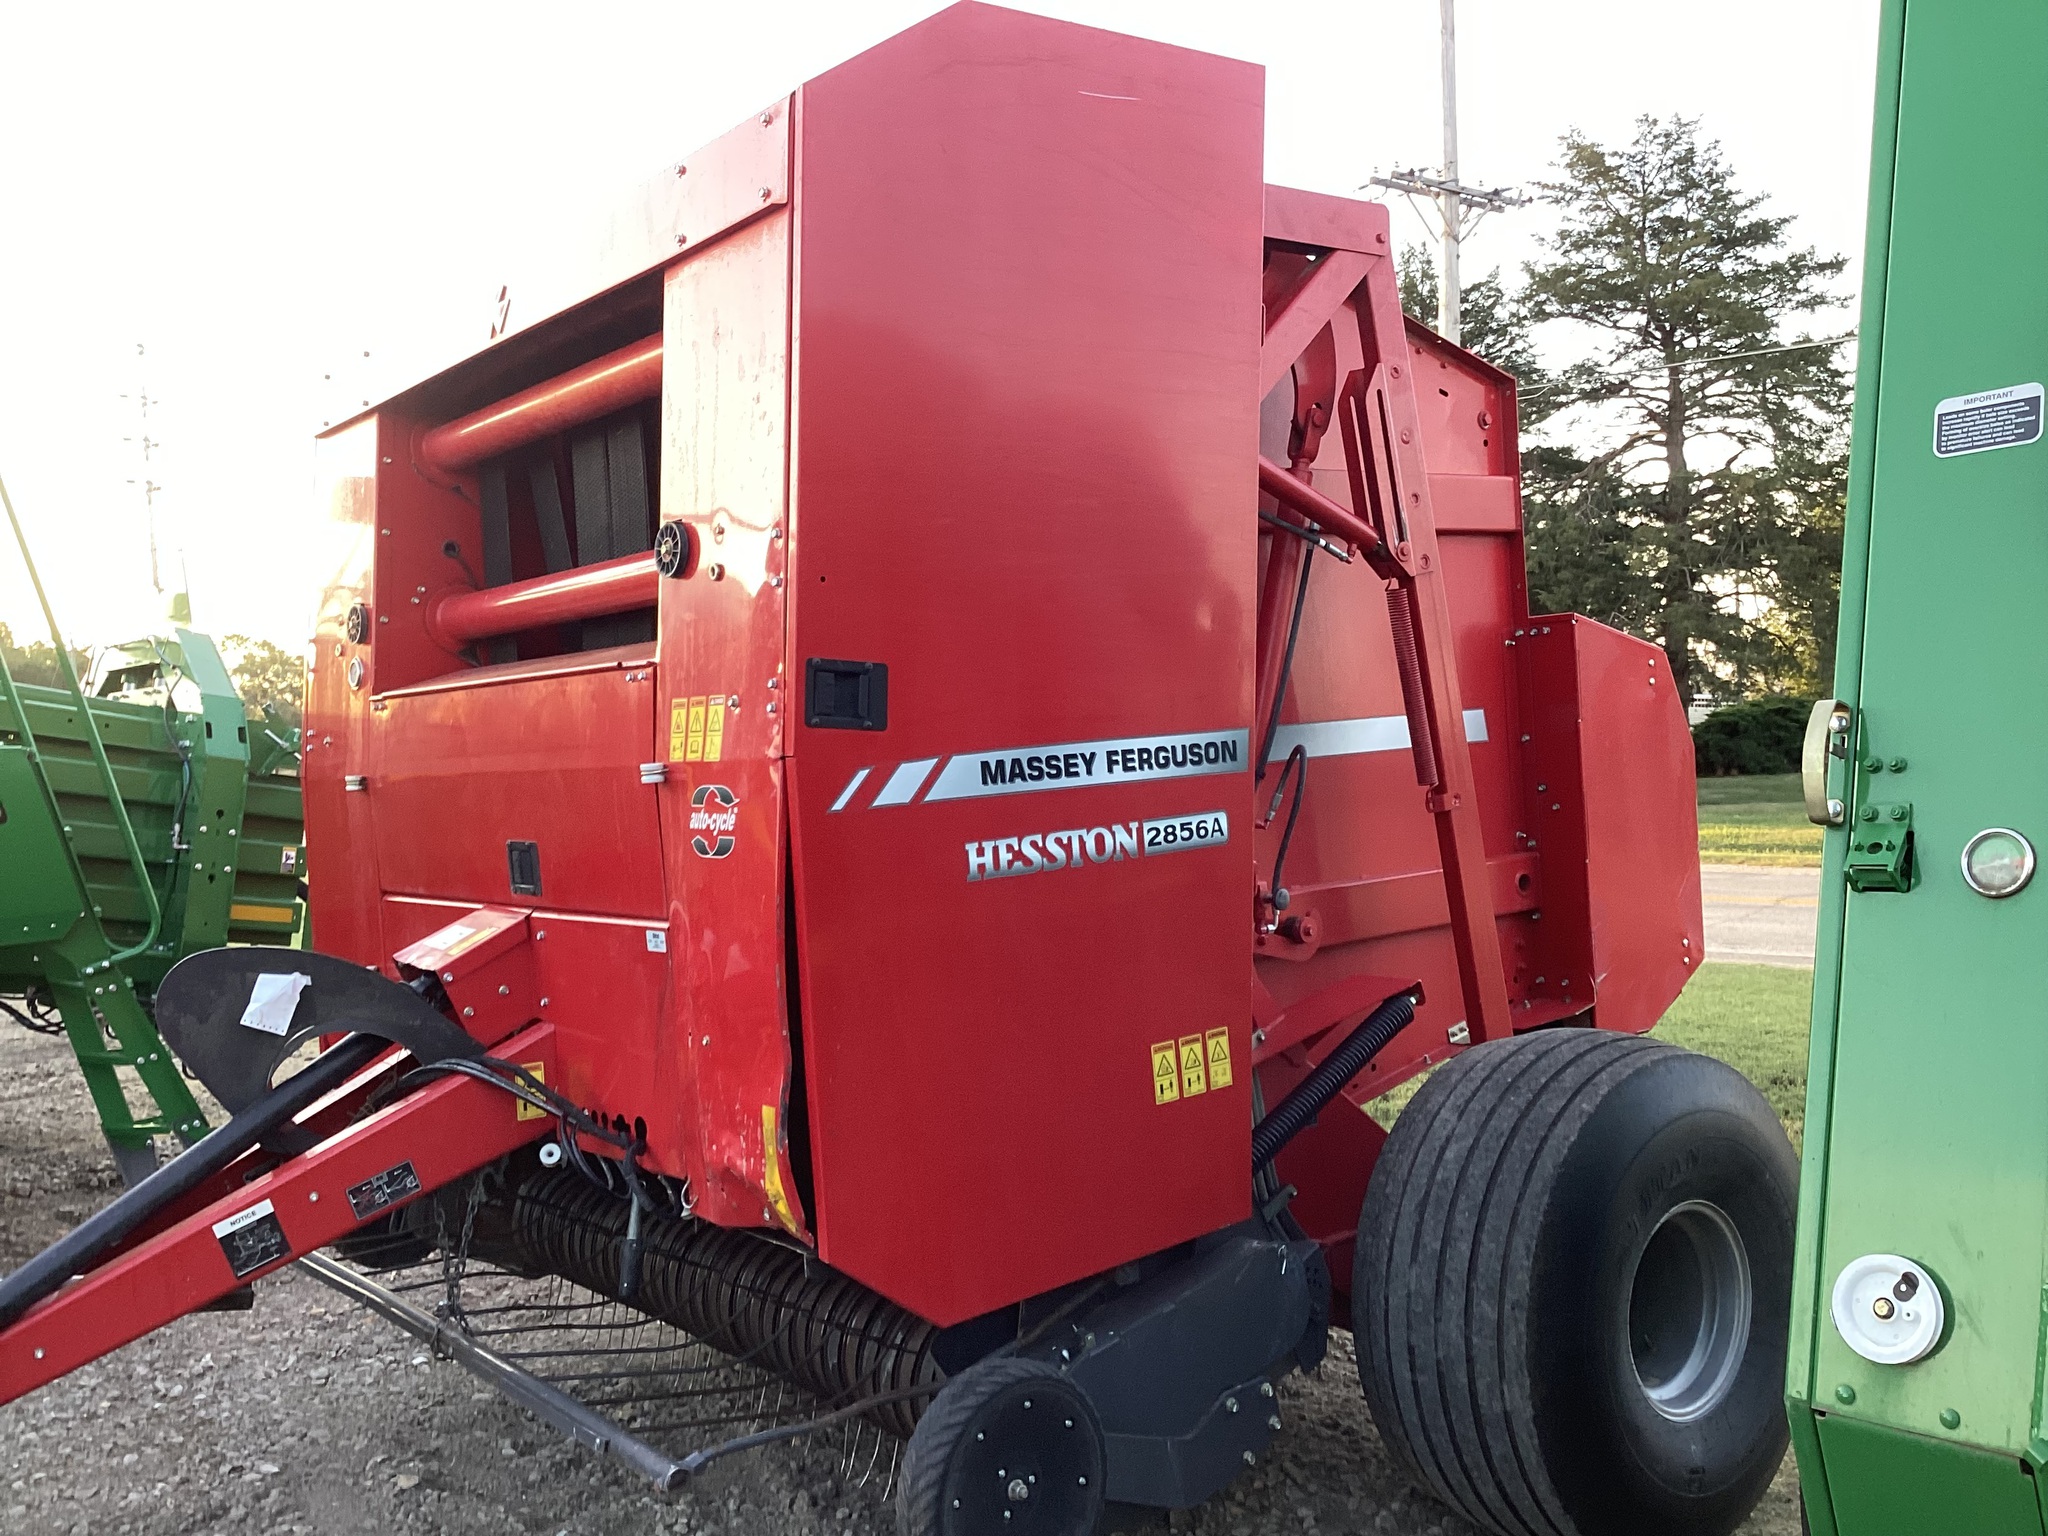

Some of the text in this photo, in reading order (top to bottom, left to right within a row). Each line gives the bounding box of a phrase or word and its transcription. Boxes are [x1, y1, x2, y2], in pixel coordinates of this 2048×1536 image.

[1964, 390, 2014, 405] IMPORTANT
[980, 739, 1238, 786] MASSEY FERGUSON
[965, 816, 1225, 882] HESSTON 2856A
[230, 1210, 257, 1226] NOTICE
